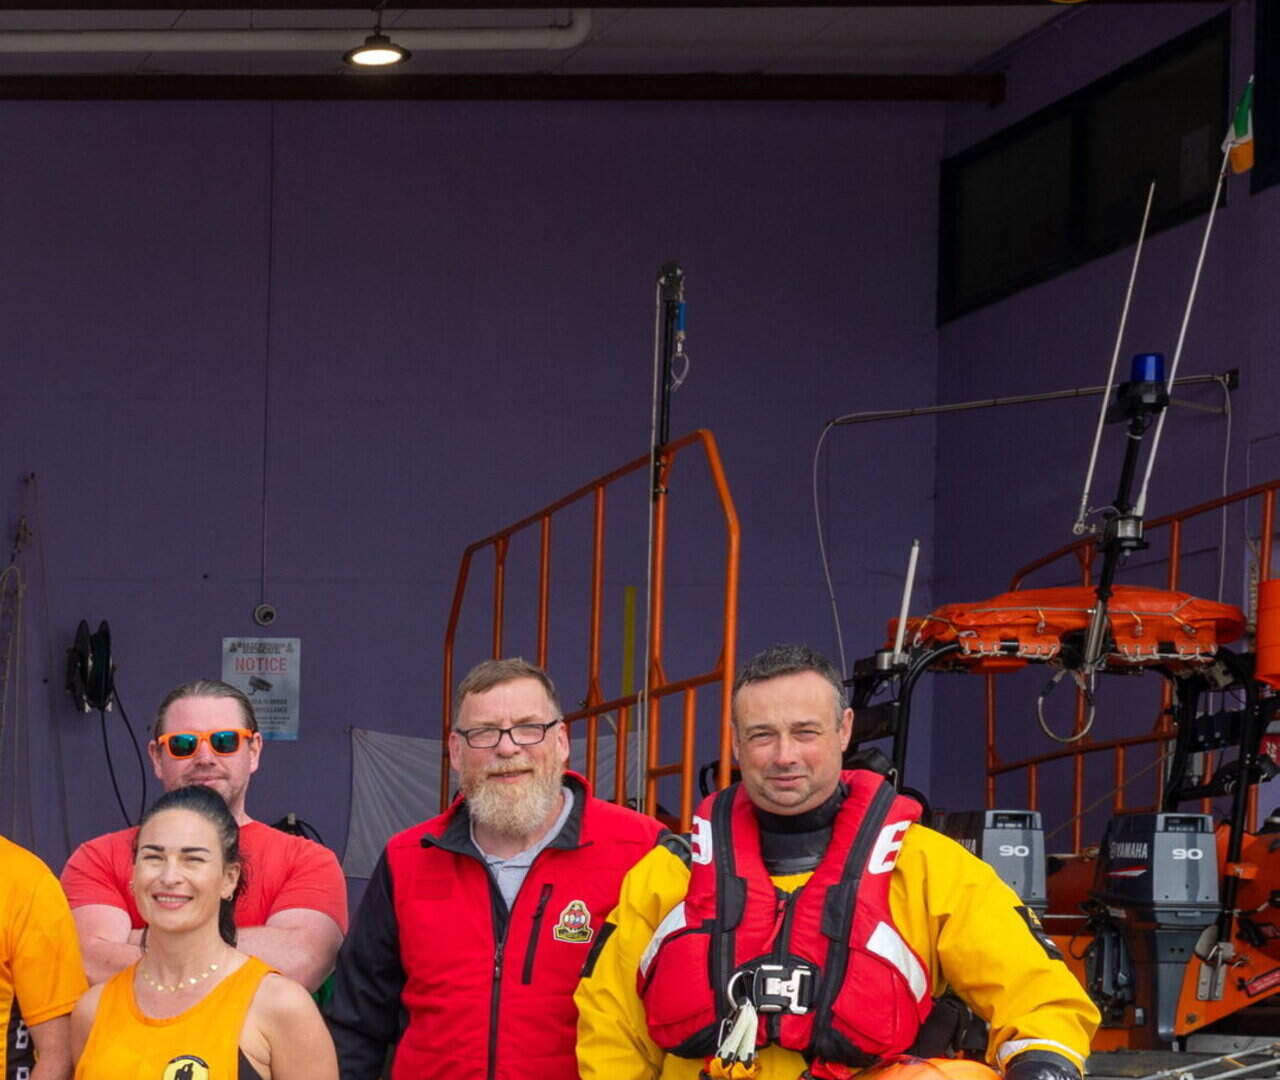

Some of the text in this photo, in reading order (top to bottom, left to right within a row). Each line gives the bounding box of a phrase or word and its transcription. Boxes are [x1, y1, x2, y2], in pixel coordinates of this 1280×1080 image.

[234, 656, 288, 672] NOTICE
[999, 844, 1030, 857] 90
[1171, 847, 1204, 861] 90
